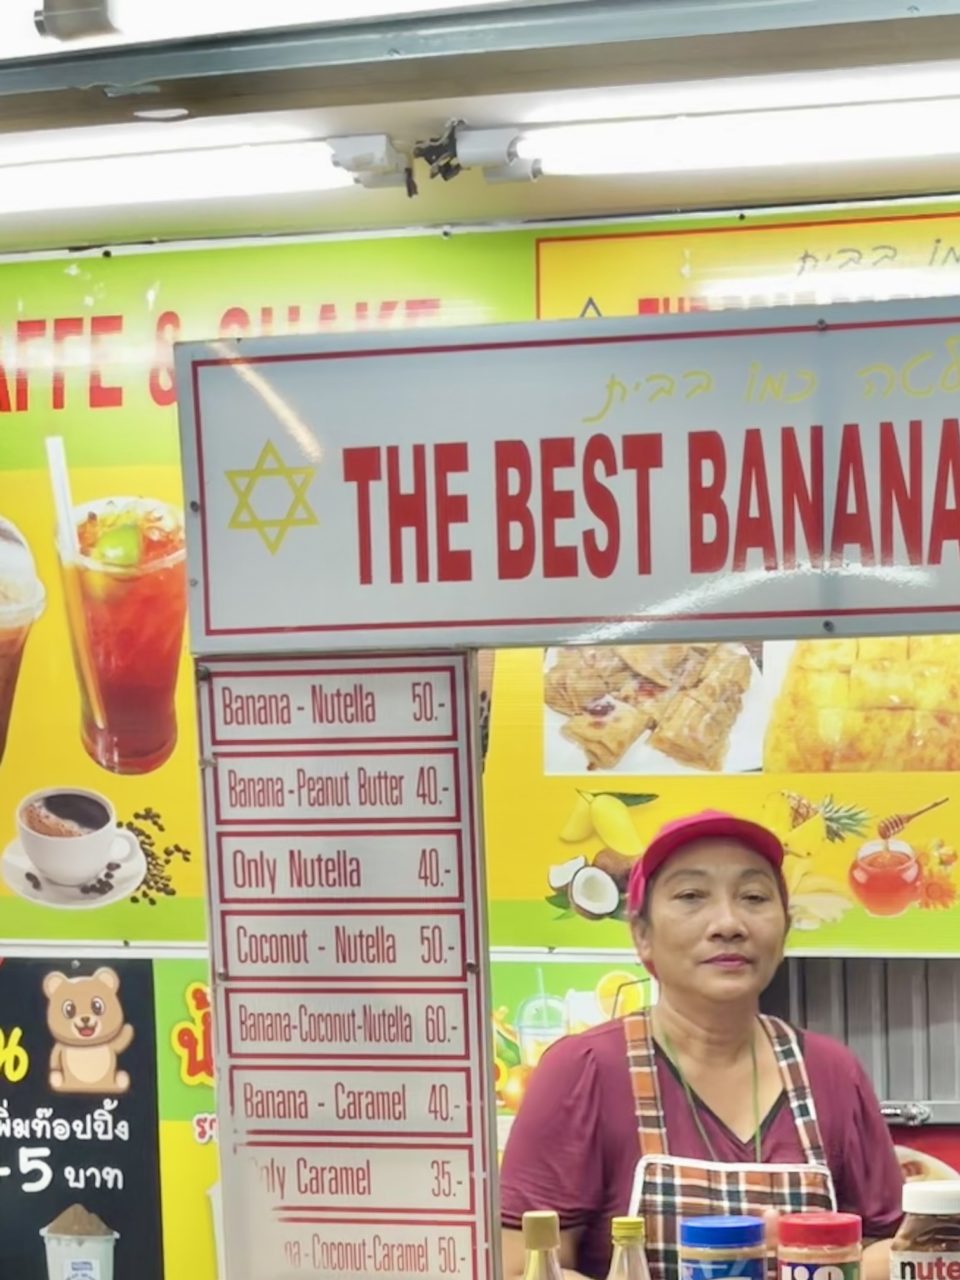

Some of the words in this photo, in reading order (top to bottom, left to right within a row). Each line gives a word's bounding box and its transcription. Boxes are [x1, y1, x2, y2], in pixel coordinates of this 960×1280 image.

[0, 316, 123, 413] FFE
[343, 441, 472, 586] THE
[494, 432, 664, 581] BEST
[222, 686, 291, 725] Banana
[311, 684, 376, 724] Nutella
[412, 682, 445, 722] 50.-
[358, 767, 405, 806] Butter
[416, 766, 449, 805] 40.-
[233, 850, 277, 894] Only
[289, 849, 361, 888] Nutella
[418, 848, 451, 887] 40.-
[236, 925, 309, 964] Coconut
[335, 925, 397, 964] Nutella
[420, 925, 455, 964] 50.-
[425, 1004, 458, 1043] 60.-
[243, 1082, 308, 1119] Banana
[334, 1081, 407, 1121] Caramel
[428, 1083, 460, 1122] 40.-
[64, 1165, 123, 1190] บาท
[296, 1157, 371, 1196] Caramel
[430, 1160, 463, 1198] 35.-
[438, 1236, 466, 1274] 50.-
